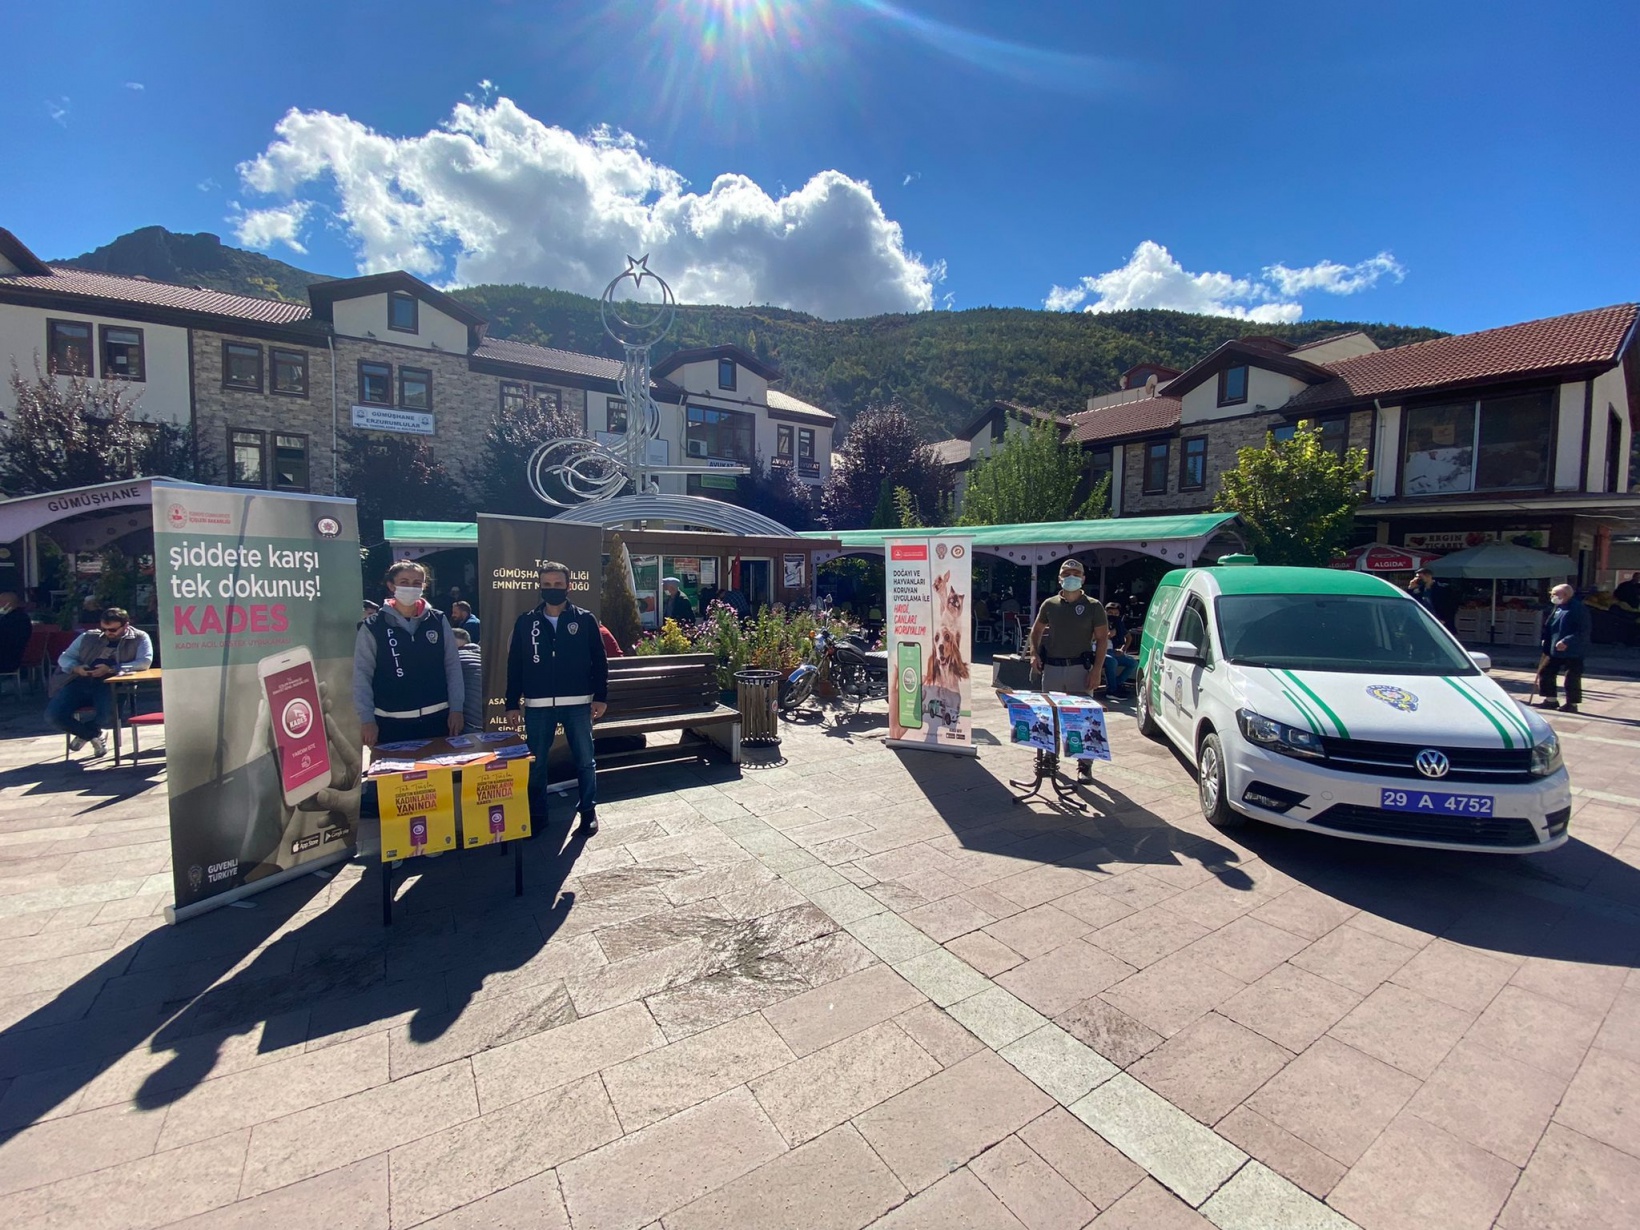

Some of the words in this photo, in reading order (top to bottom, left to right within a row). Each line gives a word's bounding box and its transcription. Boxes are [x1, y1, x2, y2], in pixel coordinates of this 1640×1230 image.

[48, 486, 141, 512] GÜMÜŞHANE
[169, 541, 261, 570] şiddete
[268, 544, 319, 573] karşı
[493, 568, 539, 579] GÜMÜŞHA
[171, 574, 212, 599] tek
[218, 573, 321, 601] dokunuş!
[492, 580, 532, 590] EMNİYET
[174, 604, 289, 636] KADES
[477, 781, 514, 792] KADINLARIN
[395, 793, 437, 805] KADINLARIN
[477, 787, 513, 801] YANINDA
[396, 800, 437, 813] YANINDA
[1384, 791, 1408, 807] 29
[1418, 794, 1434, 809] A
[1444, 796, 1491, 813] 4752
